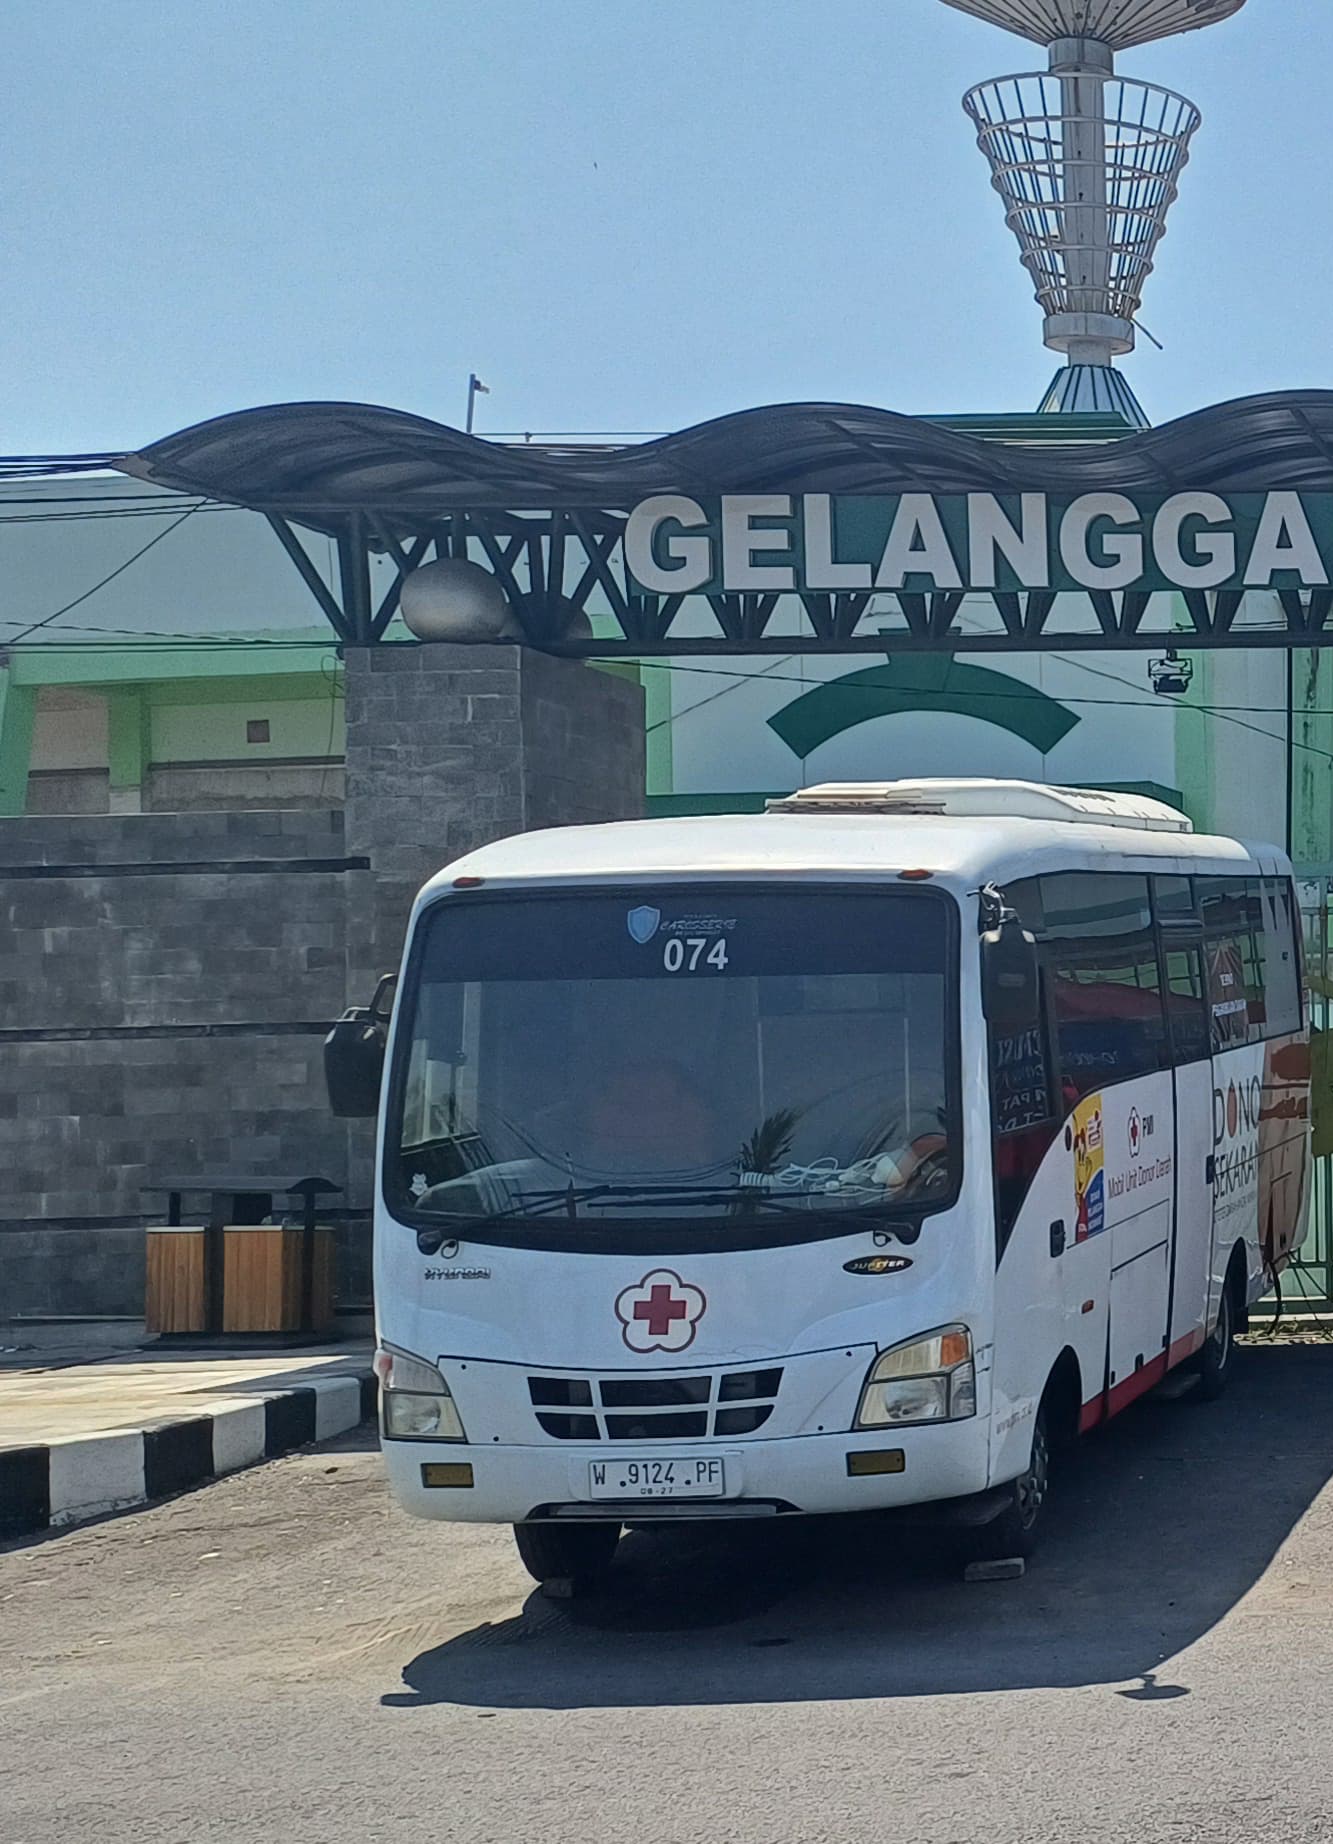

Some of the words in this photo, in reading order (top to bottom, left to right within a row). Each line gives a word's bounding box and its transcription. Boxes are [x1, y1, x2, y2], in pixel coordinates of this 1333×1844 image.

[664, 938, 728, 971] 074
[1215, 1075, 1262, 1146] DONO
[1108, 1174, 1125, 1199] Mobil
[1126, 1170, 1138, 1192] Unit
[1138, 1165, 1155, 1187] Donor
[1214, 1140, 1259, 1199] SEKARAN
[593, 1464, 606, 1485] W
[628, 1463, 675, 1484] 9124
[696, 1461, 719, 1483] PF
